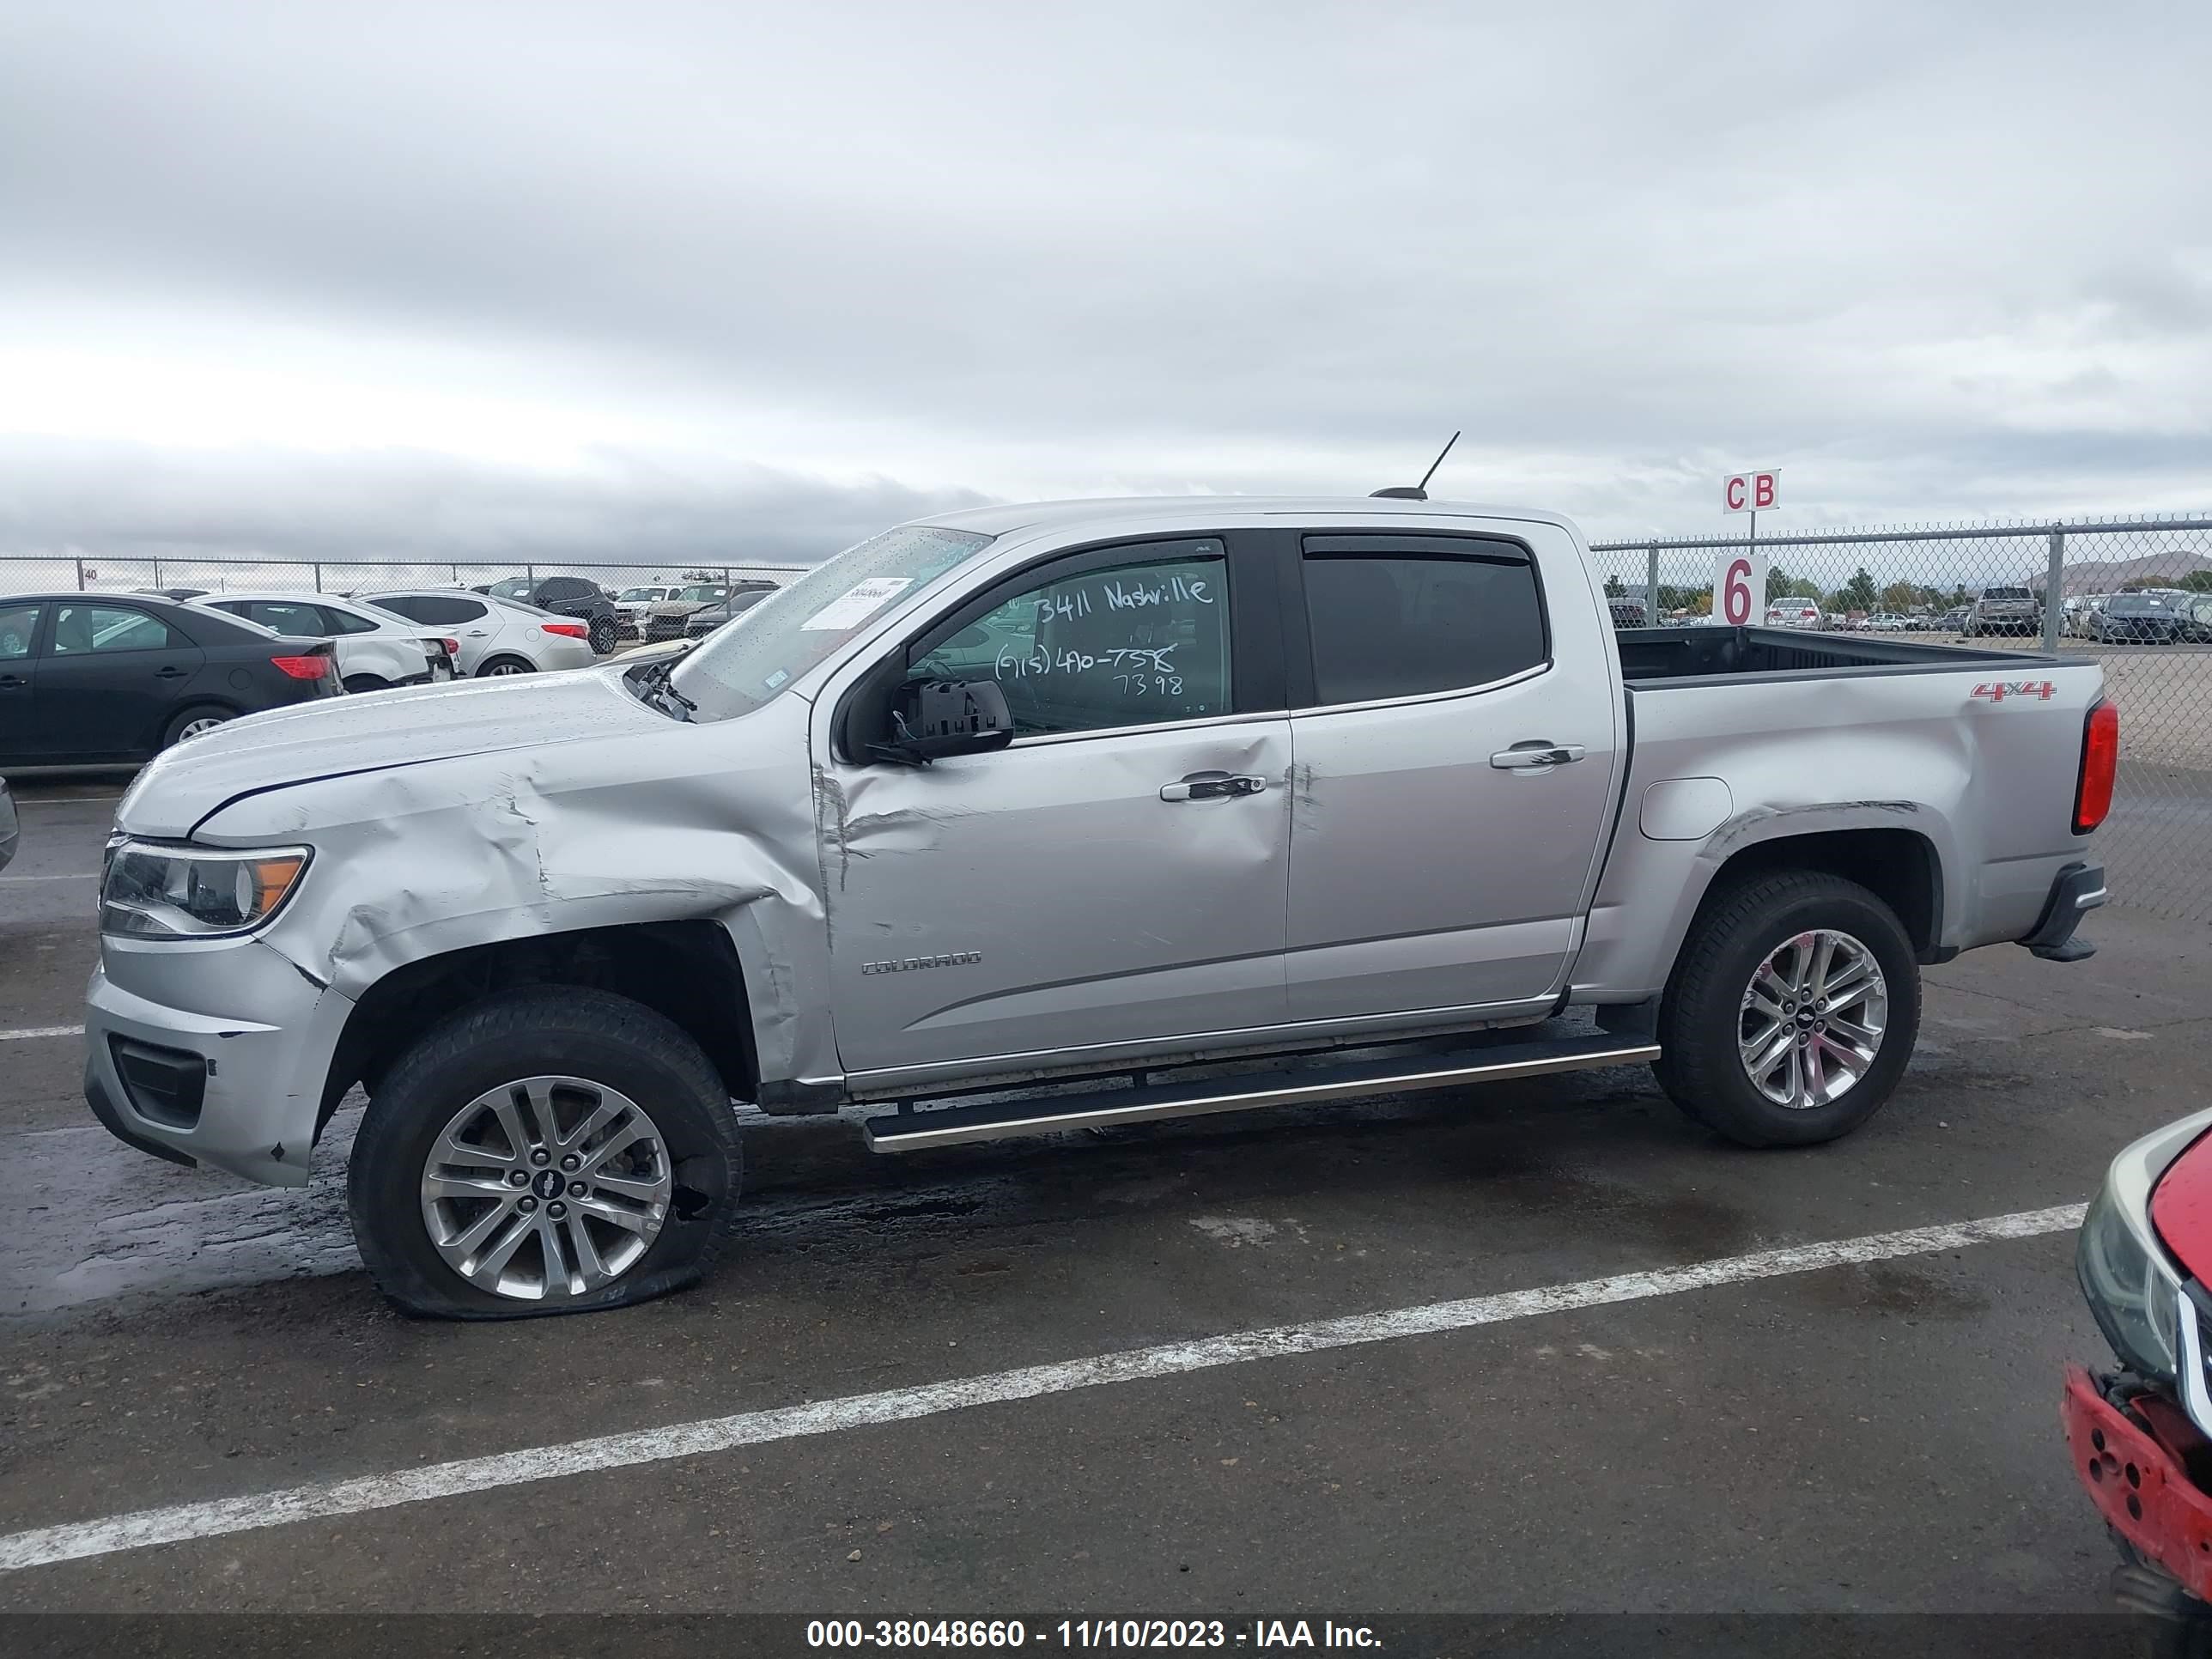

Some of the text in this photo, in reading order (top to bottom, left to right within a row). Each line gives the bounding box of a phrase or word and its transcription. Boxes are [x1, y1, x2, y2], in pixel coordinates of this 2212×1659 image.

[1727, 474, 1774, 509] C B
[85, 569, 97, 580] 40
[1034, 589, 1092, 623] 3411
[1724, 558, 1752, 626] 6
[1113, 673, 1182, 696] 7398
[862, 951, 981, 975] COLORADO
